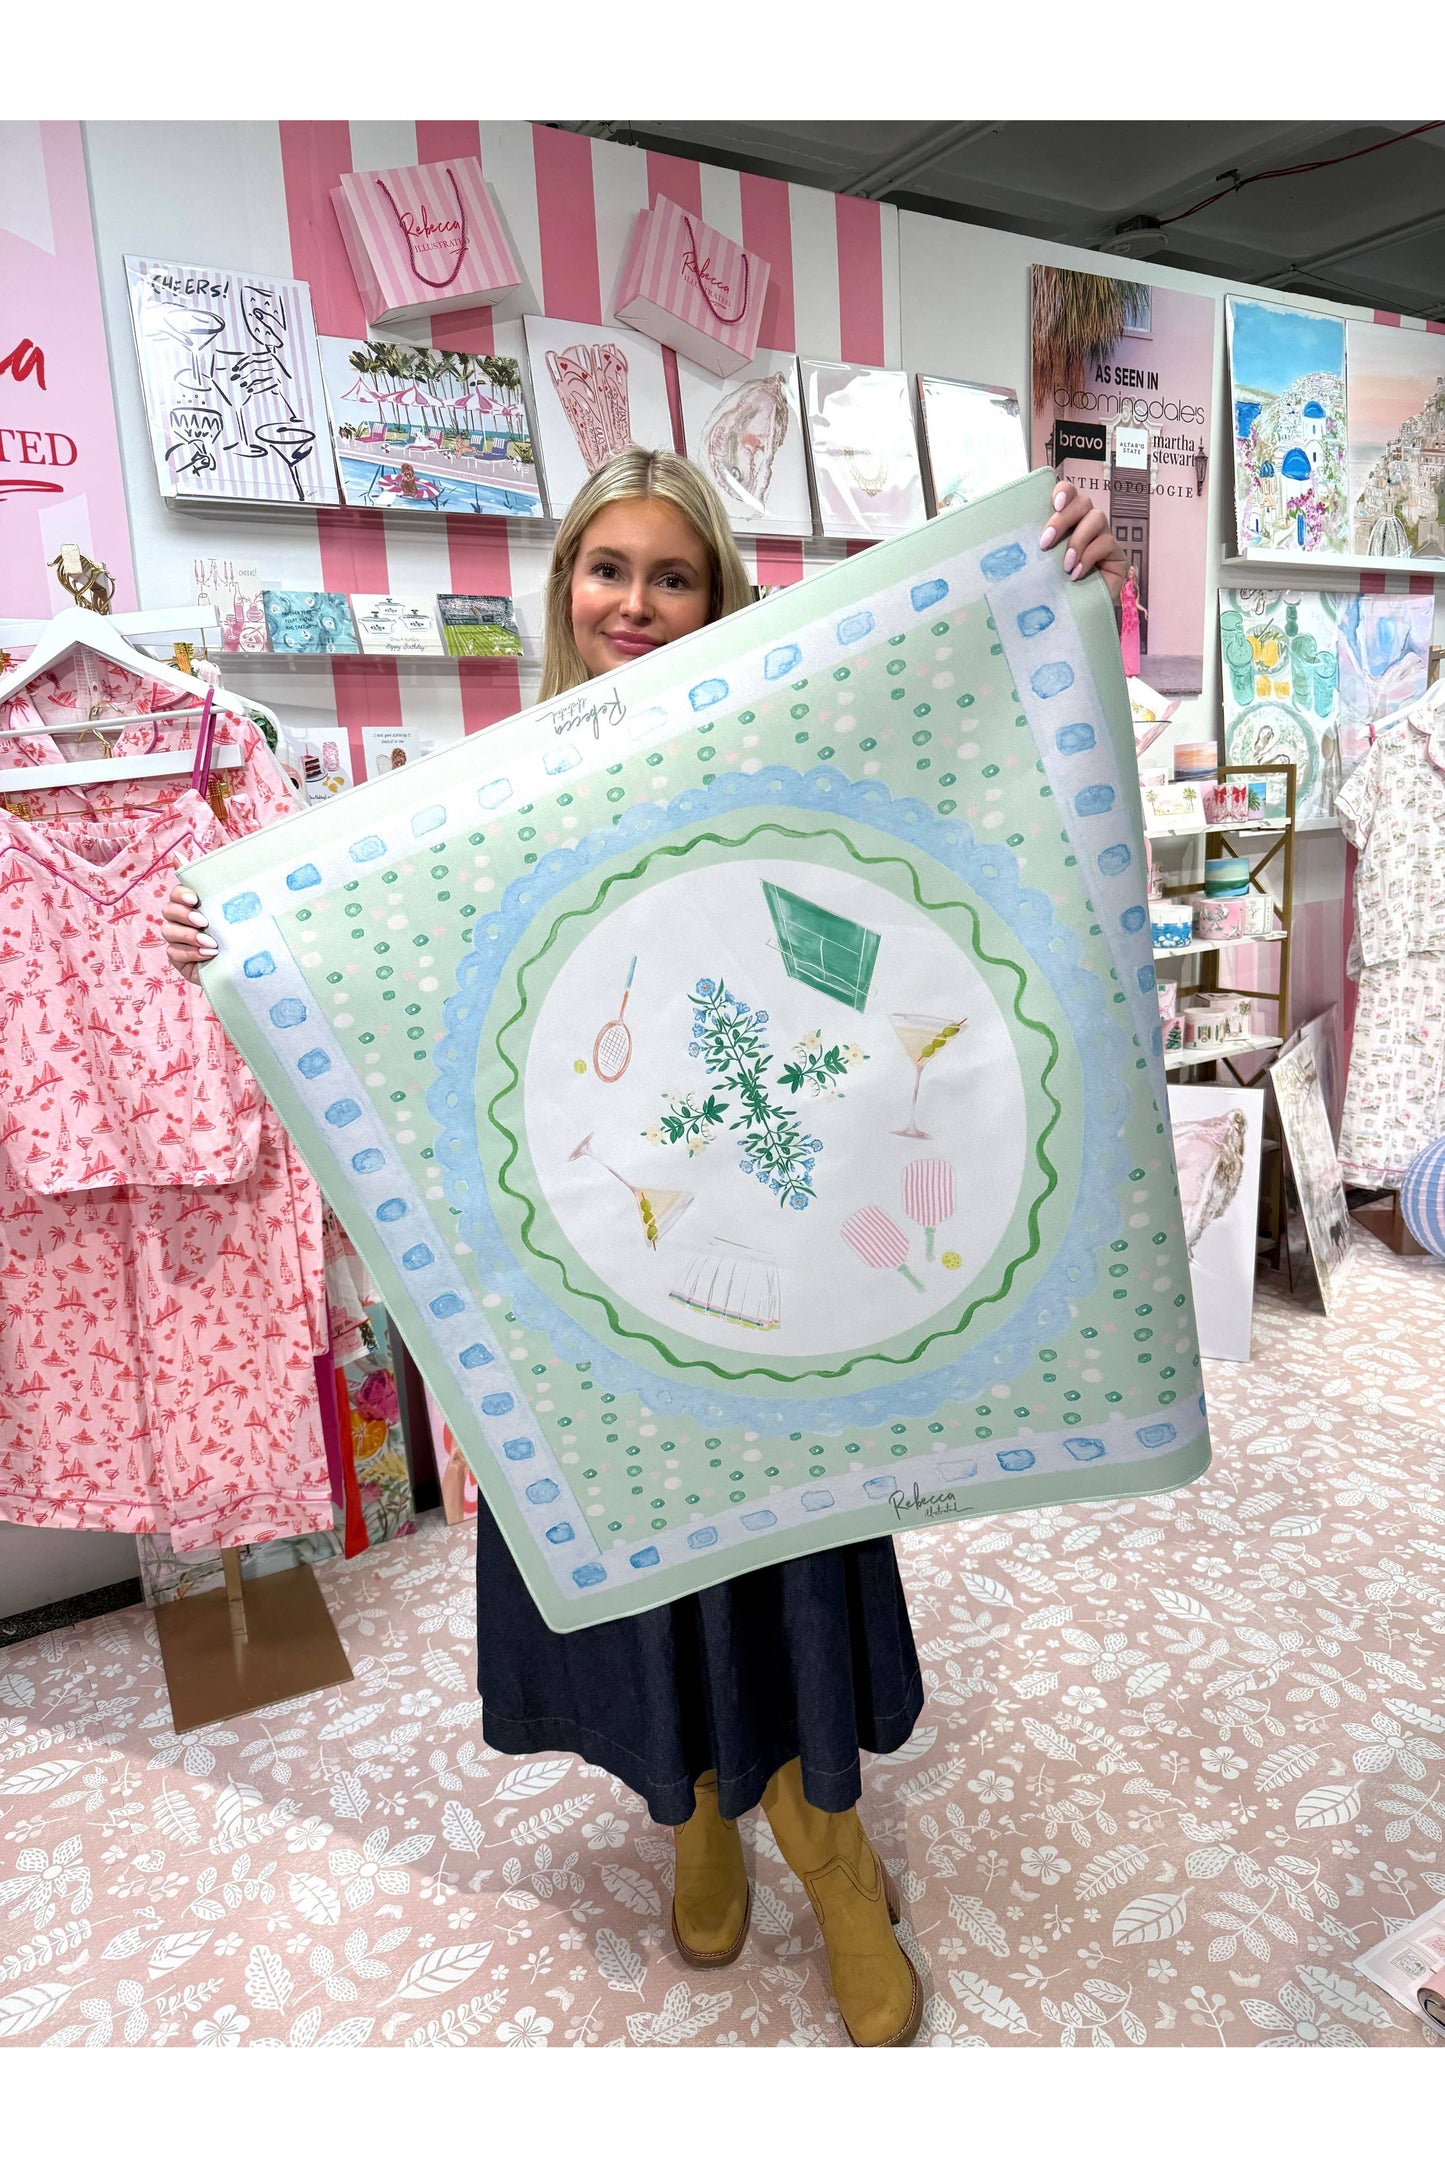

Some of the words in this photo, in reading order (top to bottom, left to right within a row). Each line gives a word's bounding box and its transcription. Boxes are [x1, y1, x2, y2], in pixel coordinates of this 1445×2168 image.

[399, 204, 461, 239] Rebecca
[681, 251, 730, 294] Rbecca
[151, 274, 230, 299] CHEERS!
[1095, 364, 1111, 384] AS
[1114, 366, 1144, 389] SEEN
[1147, 371, 1159, 391] IN
[1059, 429, 1104, 450] bravo
[1152, 434, 1195, 452] martha
[1152, 450, 1196, 468] stewart
[553, 686, 627, 741] Rebecca
[888, 1481, 956, 1521] Rebecca
